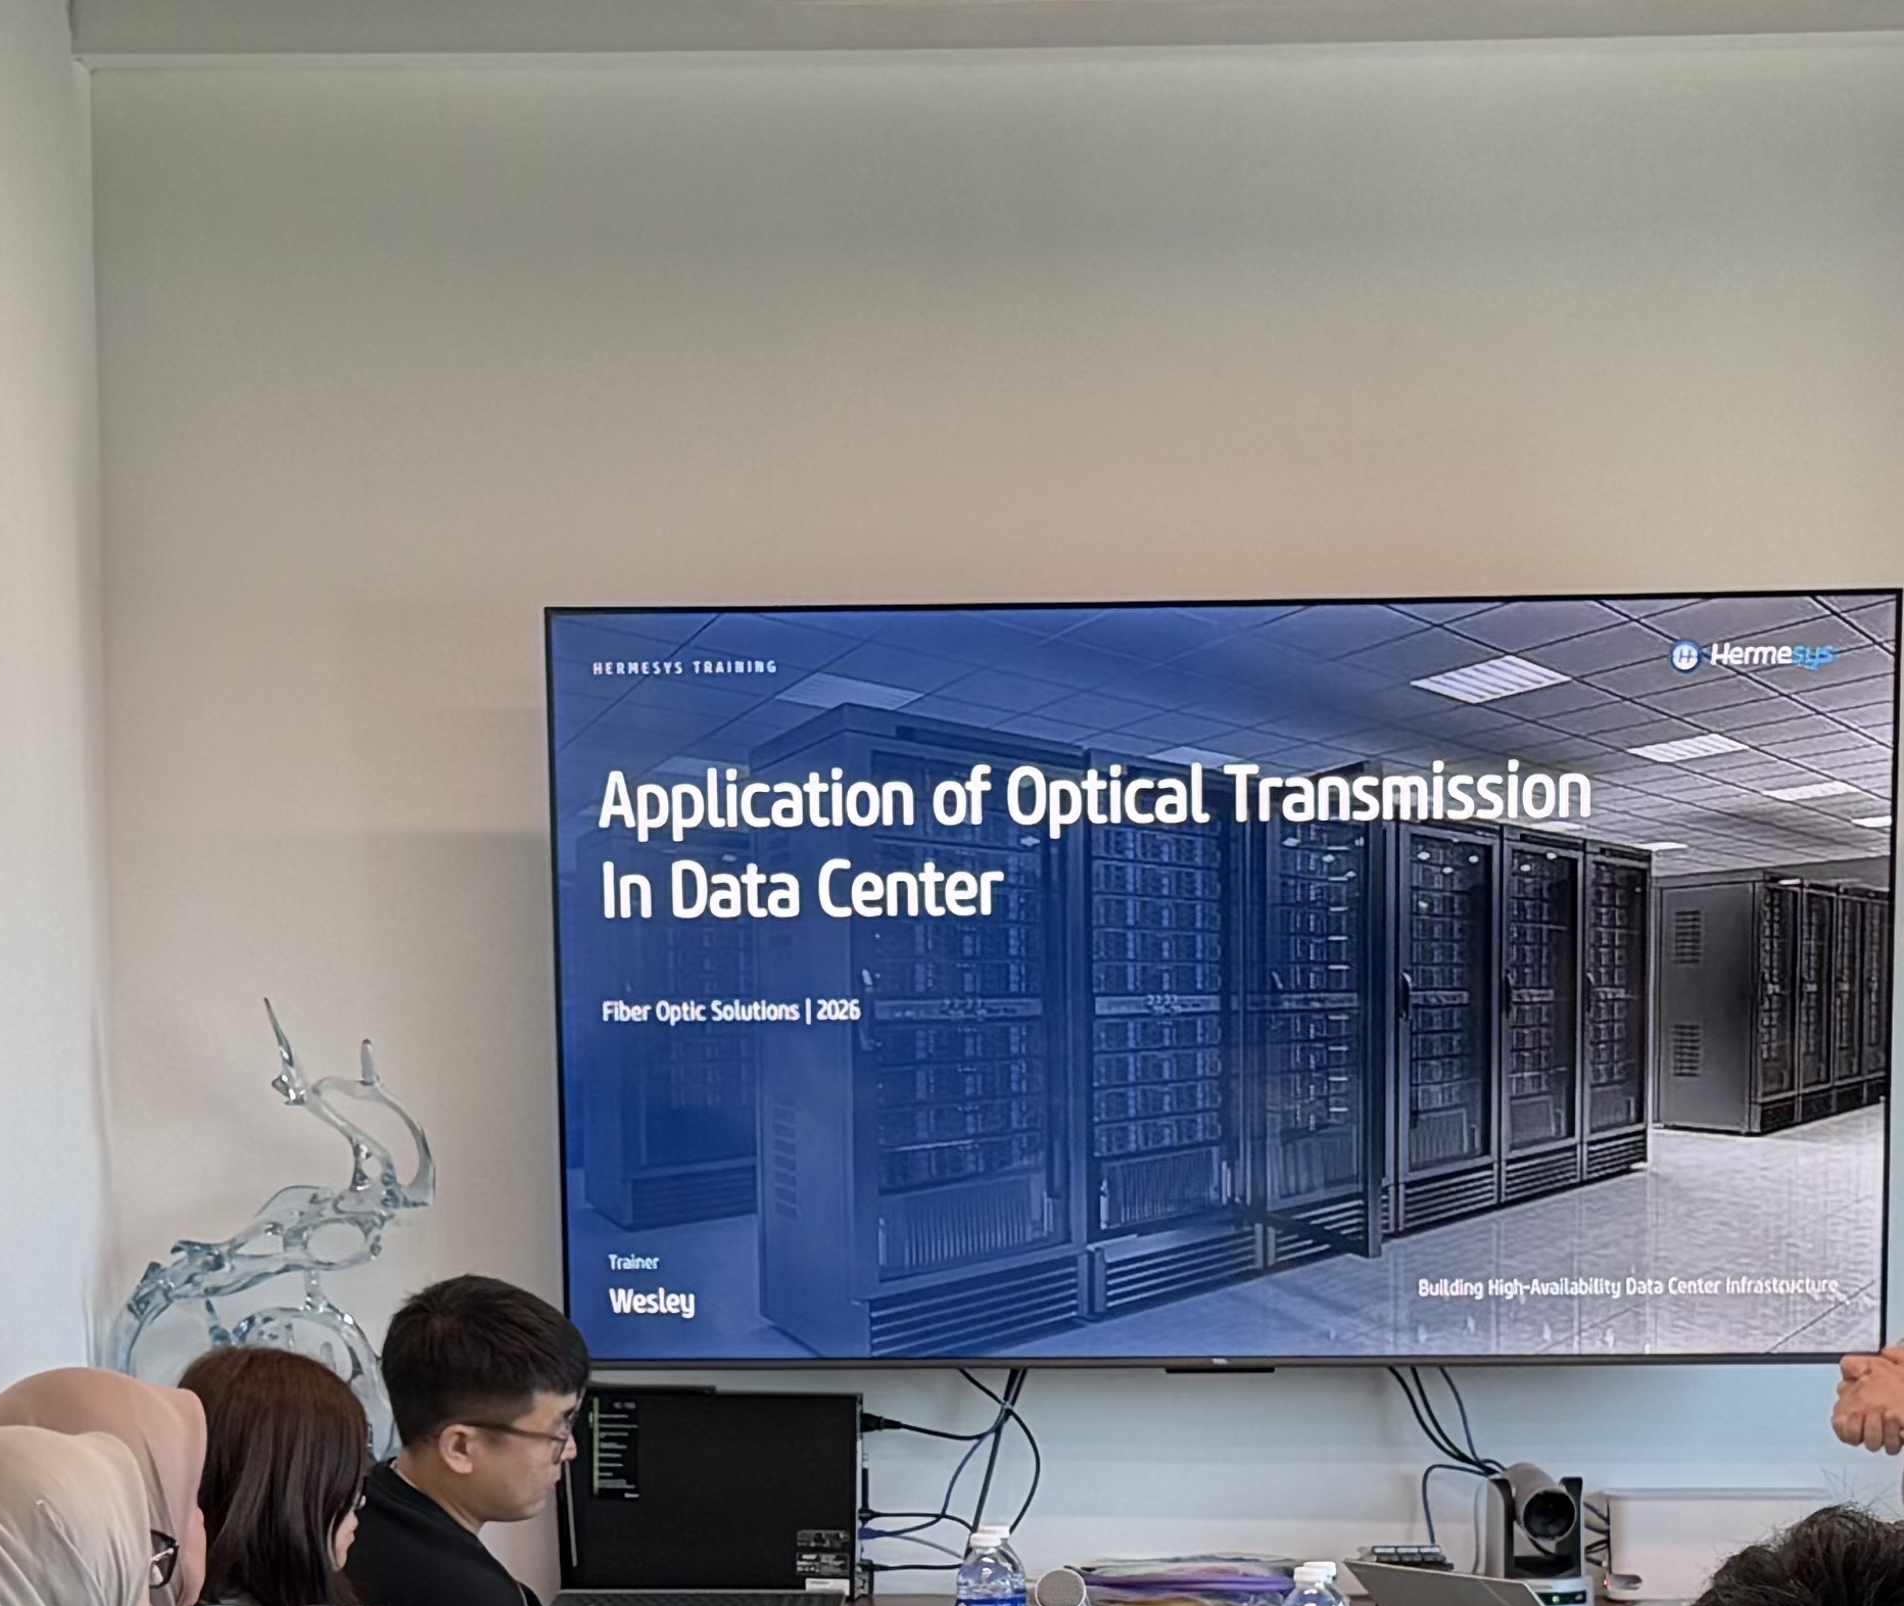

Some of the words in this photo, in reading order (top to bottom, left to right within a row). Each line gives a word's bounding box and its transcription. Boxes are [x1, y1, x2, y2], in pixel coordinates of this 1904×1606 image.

[592, 661, 683, 675] HERMESYS
[693, 660, 777, 674] TRAINING
[1711, 642, 1836, 671] Hermesys
[598, 767, 915, 843] Application
[932, 764, 992, 826] of
[1006, 762, 1211, 840] Optical
[1223, 759, 1591, 824] Transmission
[602, 860, 653, 919] In
[671, 859, 800, 919] Data
[818, 858, 1005, 918] Center
[602, 1000, 651, 1022] Fiber
[656, 1000, 707, 1026] Optic
[711, 999, 801, 1021] Solutions
[816, 999, 862, 1020] 2026
[608, 1253, 659, 1270] Trainer
[1418, 1278, 1484, 1299] Building
[1488, 1277, 1622, 1299] High-Availability
[1626, 1277, 1664, 1296] Data
[1668, 1276, 1722, 1295] Center
[608, 1287, 695, 1319] Wesley
